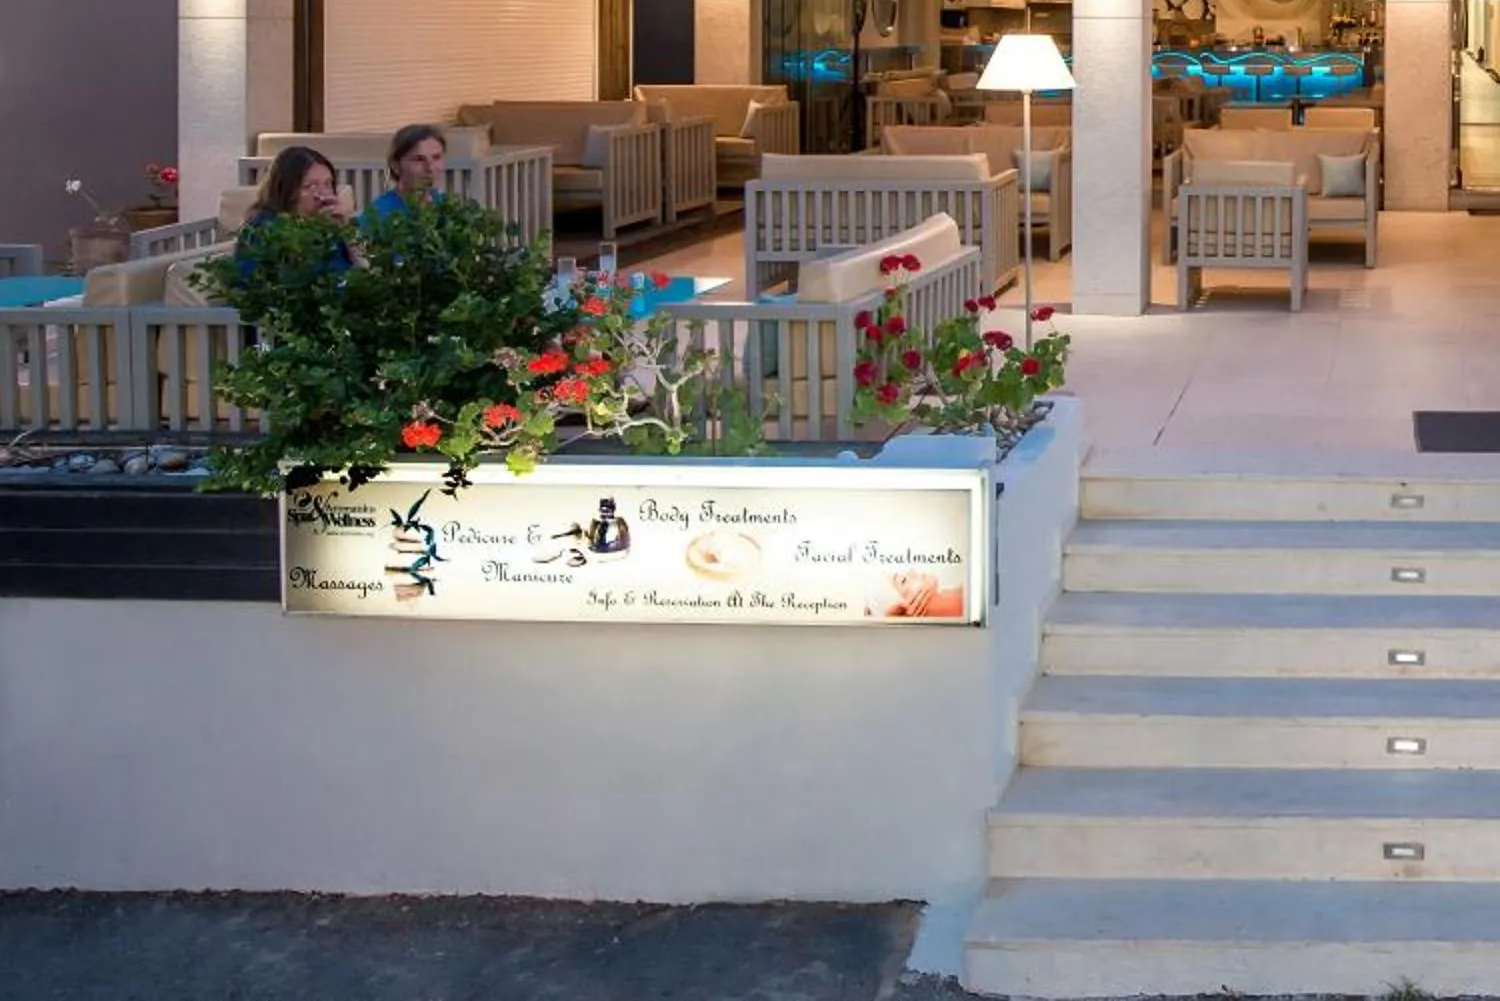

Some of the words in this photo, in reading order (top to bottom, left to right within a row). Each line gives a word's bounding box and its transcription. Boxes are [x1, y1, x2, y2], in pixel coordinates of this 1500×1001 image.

[639, 498, 690, 531] Body
[699, 499, 798, 524] Treatments
[442, 520, 518, 544] Pedicure
[794, 539, 854, 563] Facial
[862, 539, 962, 564] Treatments
[289, 566, 384, 598] Massages
[481, 560, 574, 584] Manicure
[586, 588, 617, 611] Info
[750, 591, 775, 609] The
[781, 592, 848, 614] Reception
